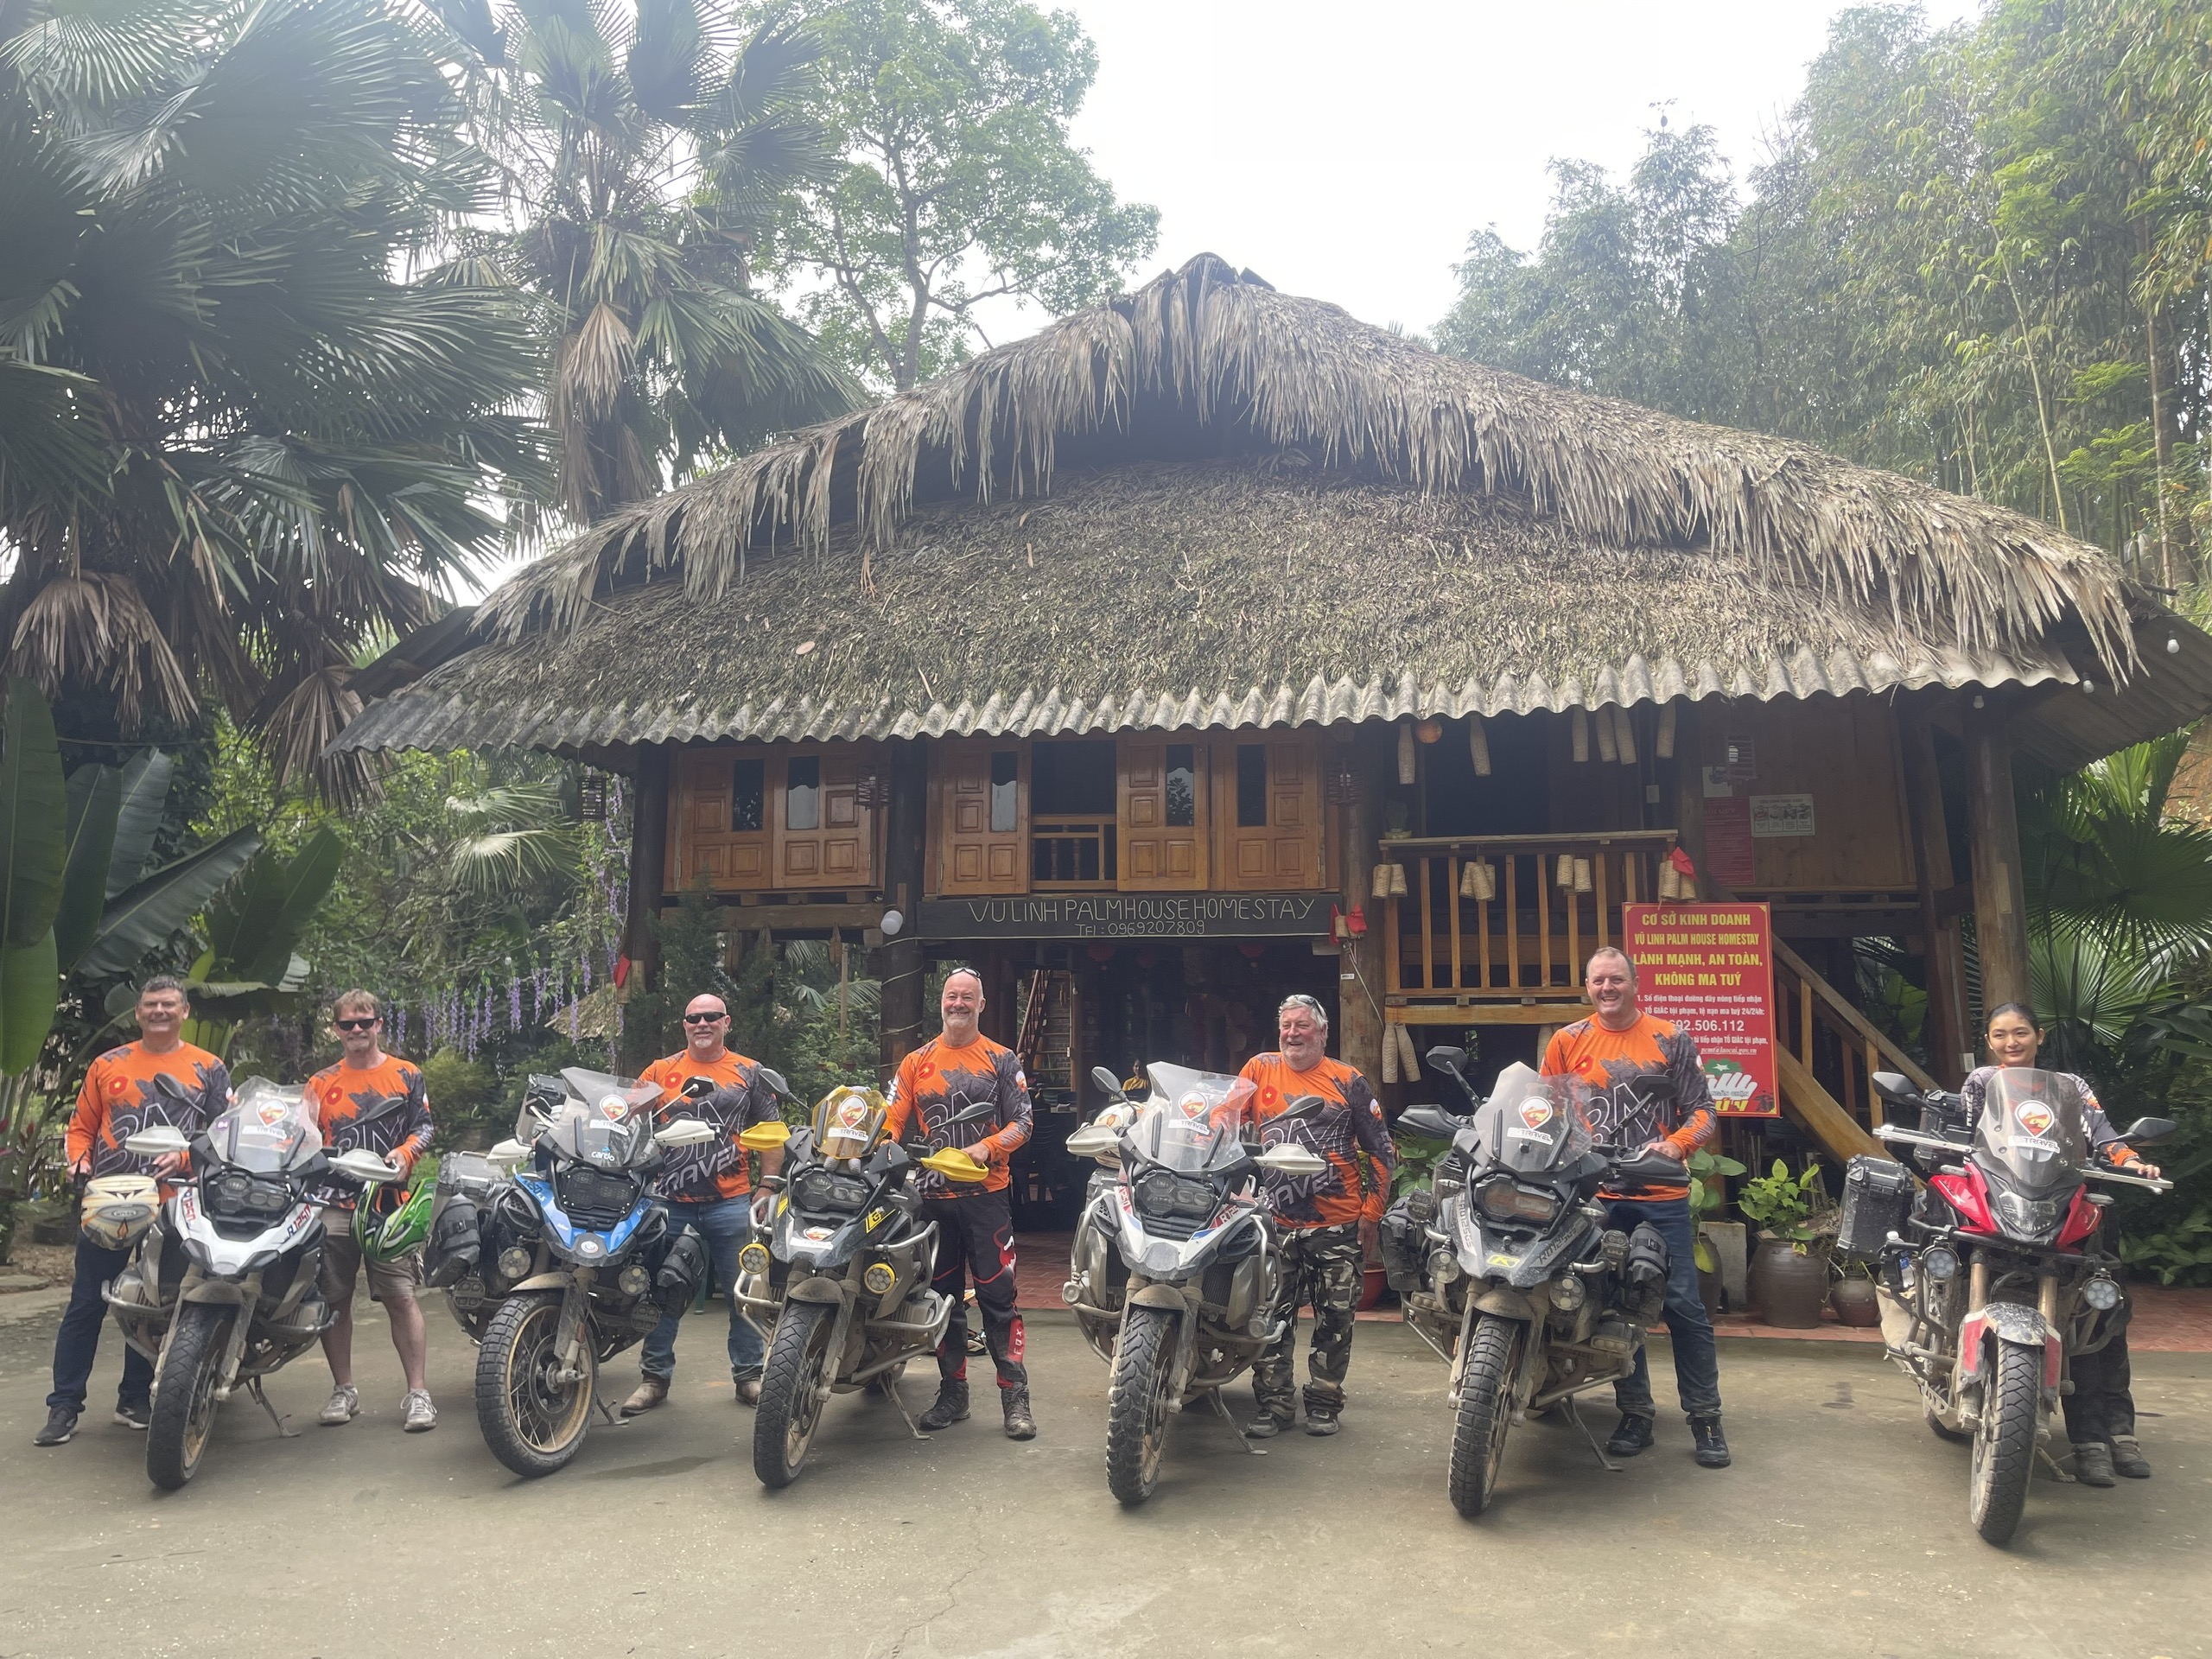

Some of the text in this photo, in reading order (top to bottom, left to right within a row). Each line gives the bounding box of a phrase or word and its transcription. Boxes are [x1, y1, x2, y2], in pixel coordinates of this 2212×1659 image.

[1193, 898, 1315, 920] HOMESTAY
[1642, 910, 1751, 925] CƠ SỞ KINH DOANH
[1107, 919, 1205, 935] 0969207809
[1647, 933, 1665, 945] LINH
[1667, 933, 1688, 945] PALM
[1691, 933, 1717, 945] HOUSE
[1719, 933, 1759, 945] HOMESTAY
[1633, 951, 1764, 968] LÀNH MẠNH, AN TOÀN,
[1655, 971, 1742, 986] KHÔNG MA TUÝ
[839, 1128, 868, 1138] TRAVEL
[1180, 1120, 1209, 1132] TRAVEL
[1520, 1128, 1552, 1142] TRAVEL
[2023, 1136, 2059, 1150] TRAVEL
[591, 1150, 615, 1162] cardo
[1014, 1328, 1023, 1356] FOX
